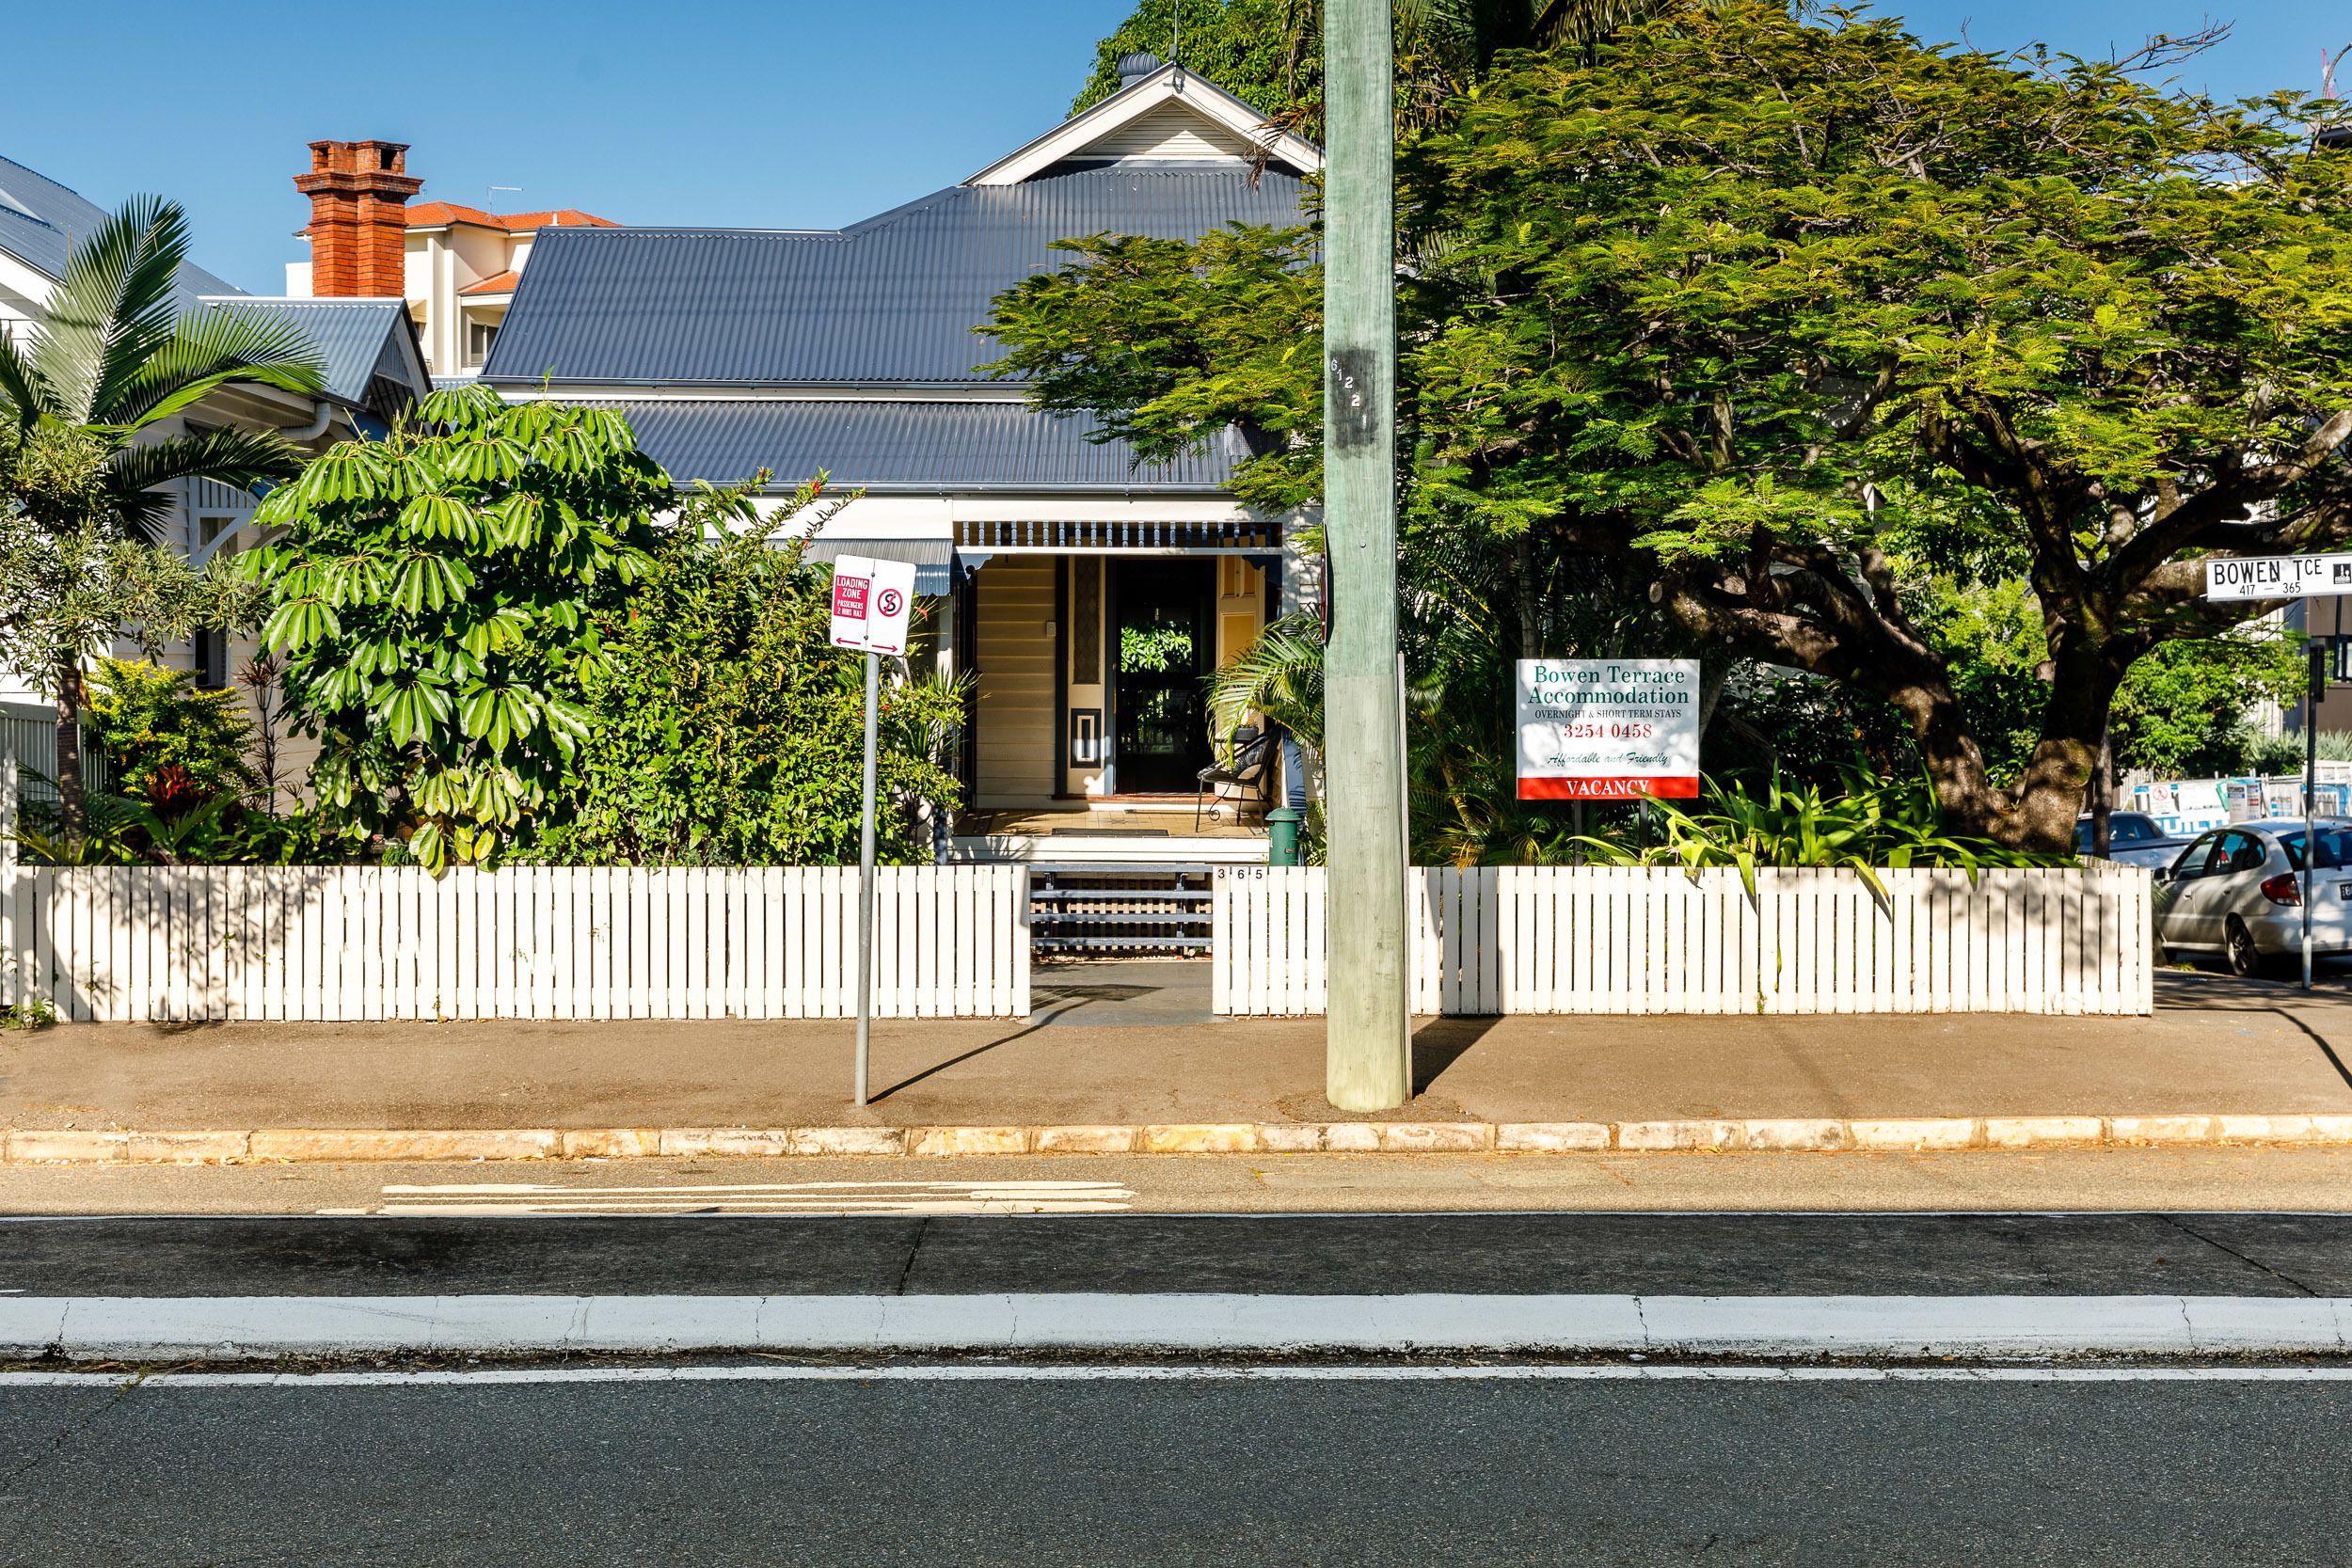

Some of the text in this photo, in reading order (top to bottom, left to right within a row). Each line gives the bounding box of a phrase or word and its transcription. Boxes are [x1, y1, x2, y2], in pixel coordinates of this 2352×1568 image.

[2214, 559, 2323, 585] BOWEN TCE
[836, 576, 868, 590] LOADING
[2239, 584, 2255, 595] 417
[2282, 581, 2301, 594] 365
[842, 587, 862, 599] ZONE
[1534, 665, 1685, 683] Bowen Terrace
[1528, 687, 1689, 704] Accommodation
[1534, 709, 1681, 719] OVERNIGHT & SHORT TERM STAYS
[1564, 723, 1652, 738] 3254 0458
[1547, 752, 1668, 767] Affordable and Friendly
[1566, 780, 1649, 796] VACANCY
